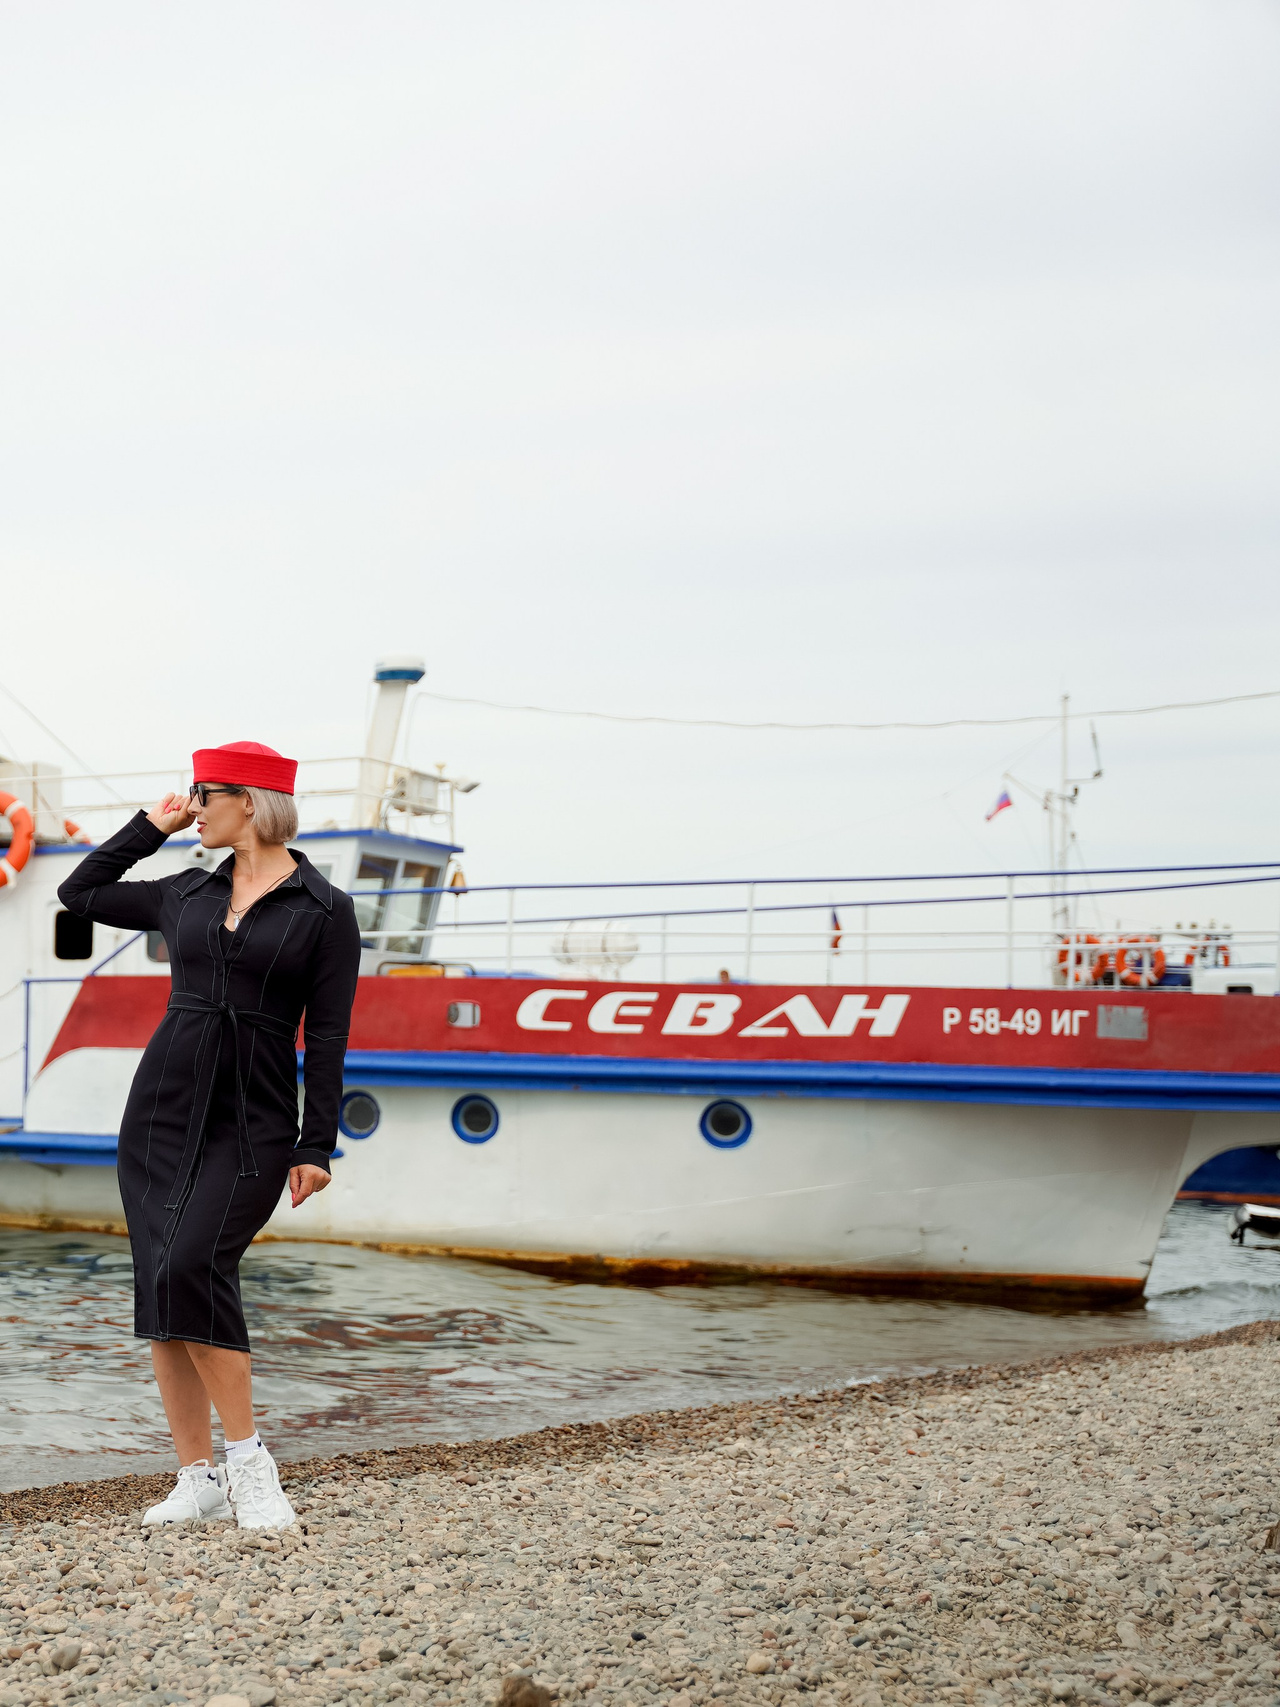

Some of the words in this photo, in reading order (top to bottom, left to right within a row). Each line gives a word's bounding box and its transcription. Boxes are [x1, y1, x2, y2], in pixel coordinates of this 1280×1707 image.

[516, 989, 911, 1037] СЕВАН
[942, 1007, 962, 1034] Р
[969, 1007, 1042, 1036] 58-49
[1051, 1008, 1090, 1036] ИГ
